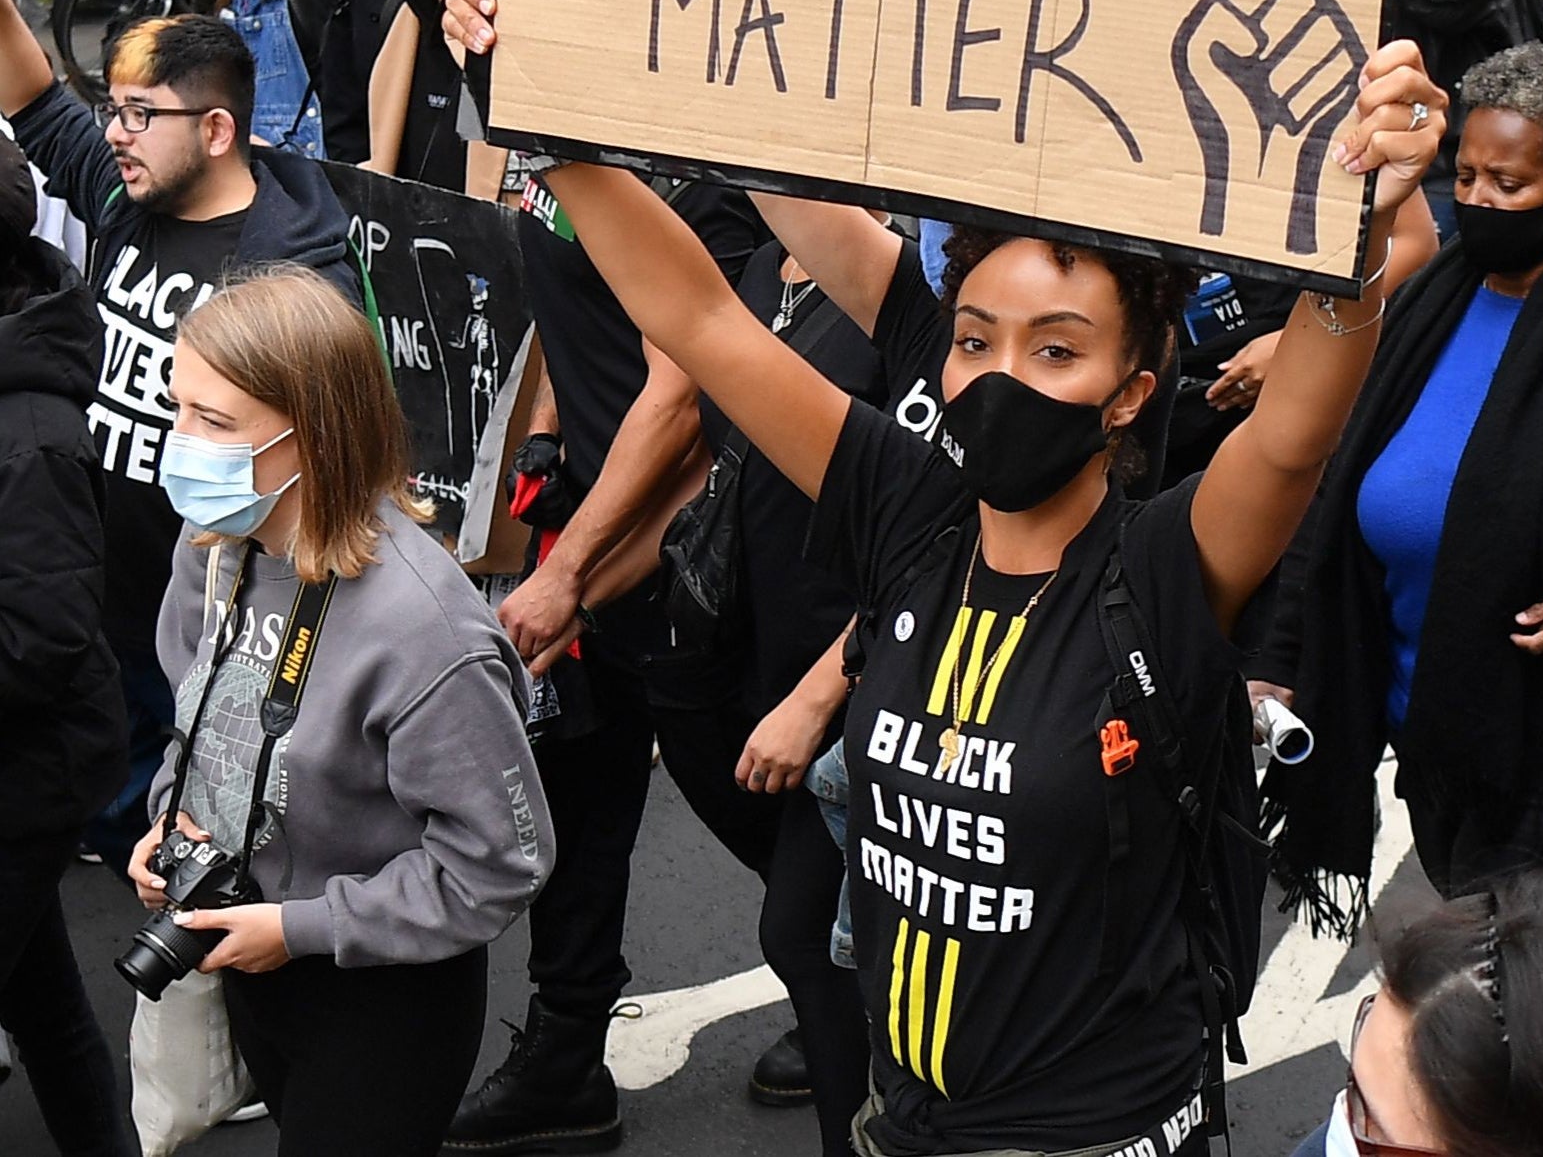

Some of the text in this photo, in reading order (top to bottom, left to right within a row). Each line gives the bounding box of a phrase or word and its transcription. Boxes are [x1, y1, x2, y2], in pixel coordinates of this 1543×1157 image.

[347, 215, 390, 272] OP
[103, 245, 214, 329] LAC
[208, 599, 285, 661] NAS
[281, 626, 312, 684] Nikon
[1129, 650, 1157, 697] OMM
[866, 709, 1017, 794] BLACK
[506, 780, 539, 862] NEED
[871, 782, 1005, 865] LIVES
[860, 837, 1035, 933] MATTER
